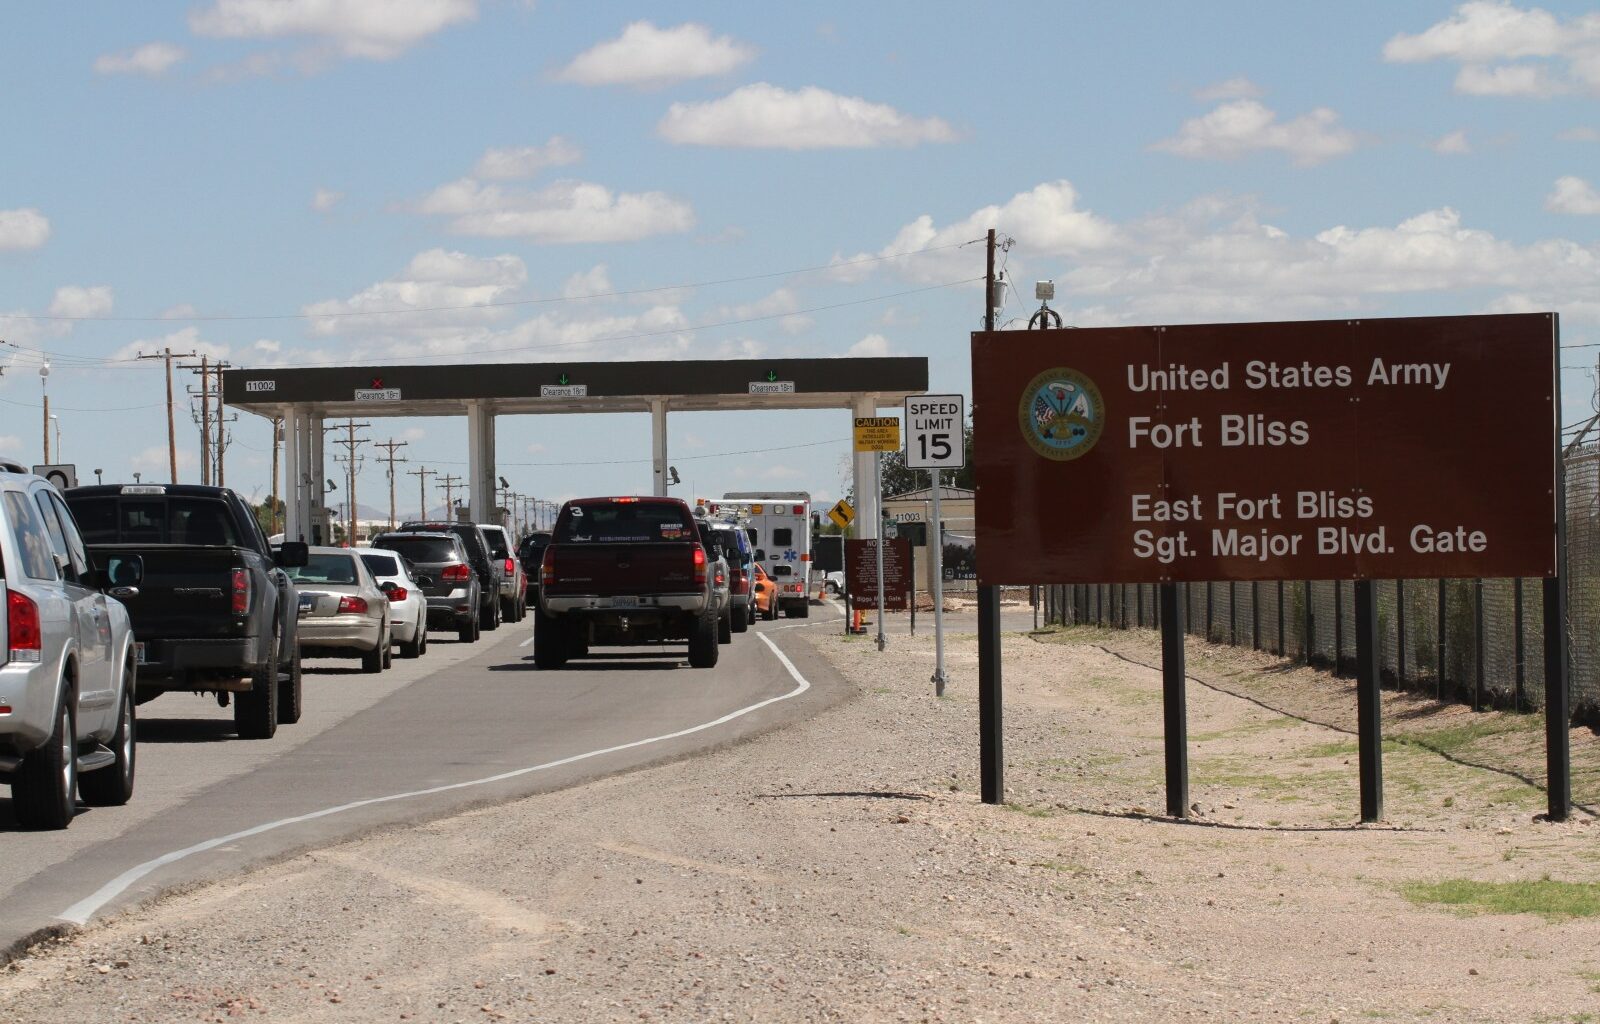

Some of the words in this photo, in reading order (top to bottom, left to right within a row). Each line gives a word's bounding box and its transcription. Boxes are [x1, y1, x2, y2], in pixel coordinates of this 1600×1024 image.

[1127, 362, 1230, 392] United
[1245, 360, 1352, 389] States
[1366, 357, 1451, 390] Army
[247, 381, 274, 391] 11002
[356, 391, 385, 400] Clearance
[910, 403, 959, 415] SPEED
[856, 418, 898, 427] CAUTION
[915, 418, 954, 430] LIMIT
[1128, 416, 1203, 448] Fort
[1220, 413, 1310, 447] Bliss
[917, 433, 952, 460] 15
[570, 506, 584, 517] 3
[1131, 494, 1203, 522] East
[1217, 492, 1282, 520] Fort
[1297, 490, 1374, 519] Bliss
[896, 513, 921, 521] 11003
[1132, 529, 1197, 564] Sgt.
[1211, 528, 1303, 562] Major
[1317, 526, 1395, 555] Blvd.
[1409, 524, 1488, 554] Gate
